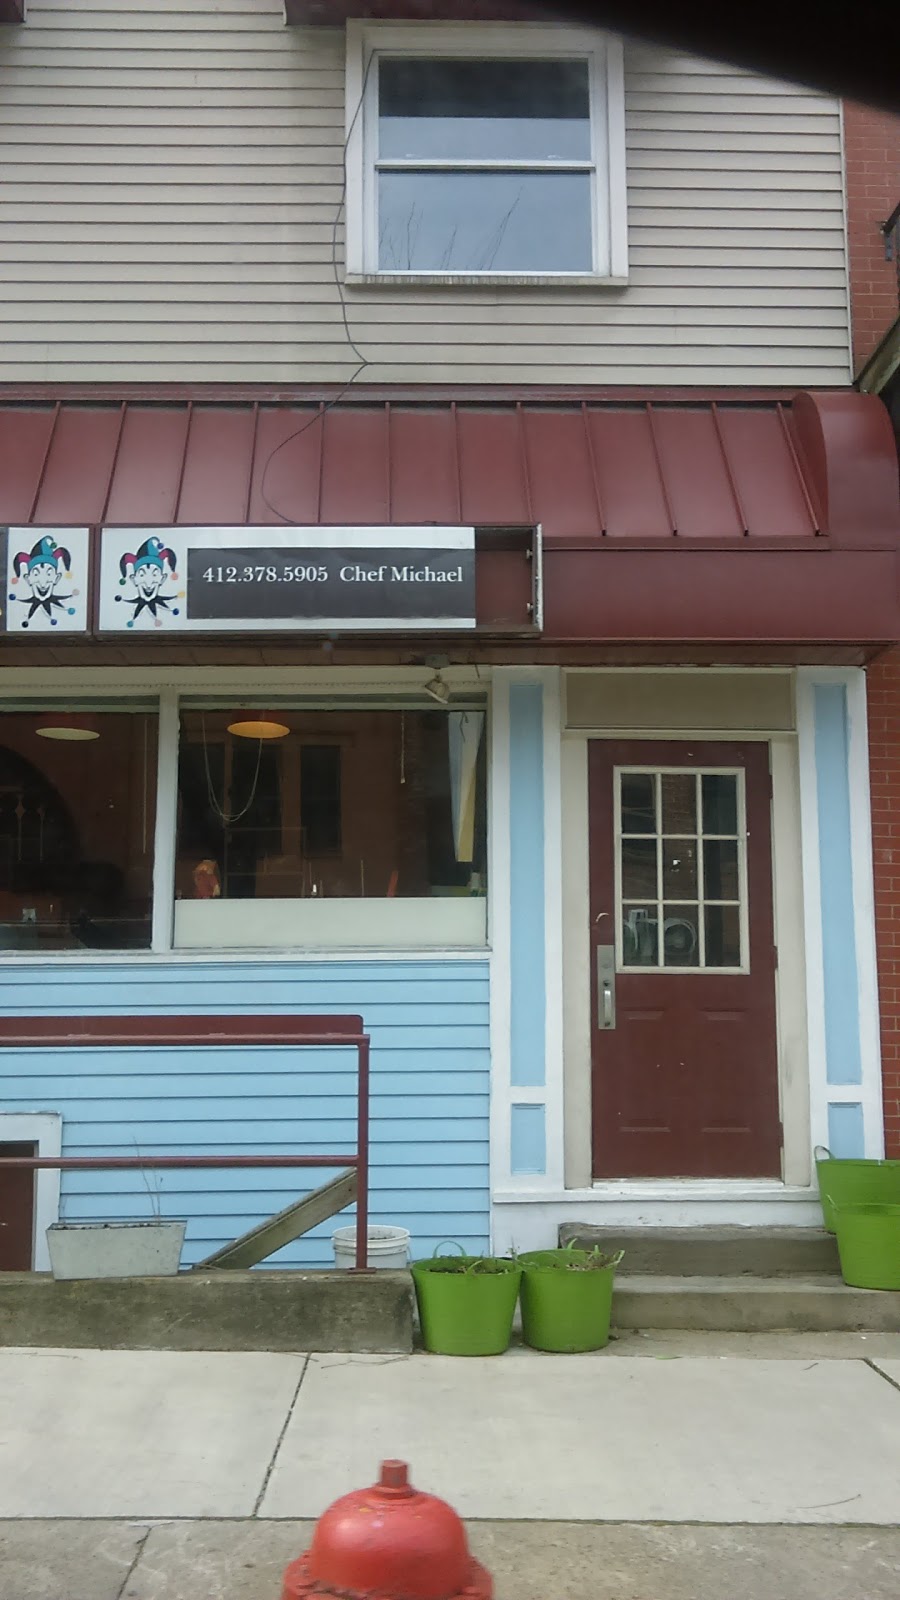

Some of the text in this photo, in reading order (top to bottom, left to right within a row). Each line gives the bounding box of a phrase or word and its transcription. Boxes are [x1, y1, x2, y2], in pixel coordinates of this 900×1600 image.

[202, 565, 463, 582] 412.378.5905 Chef Michael
